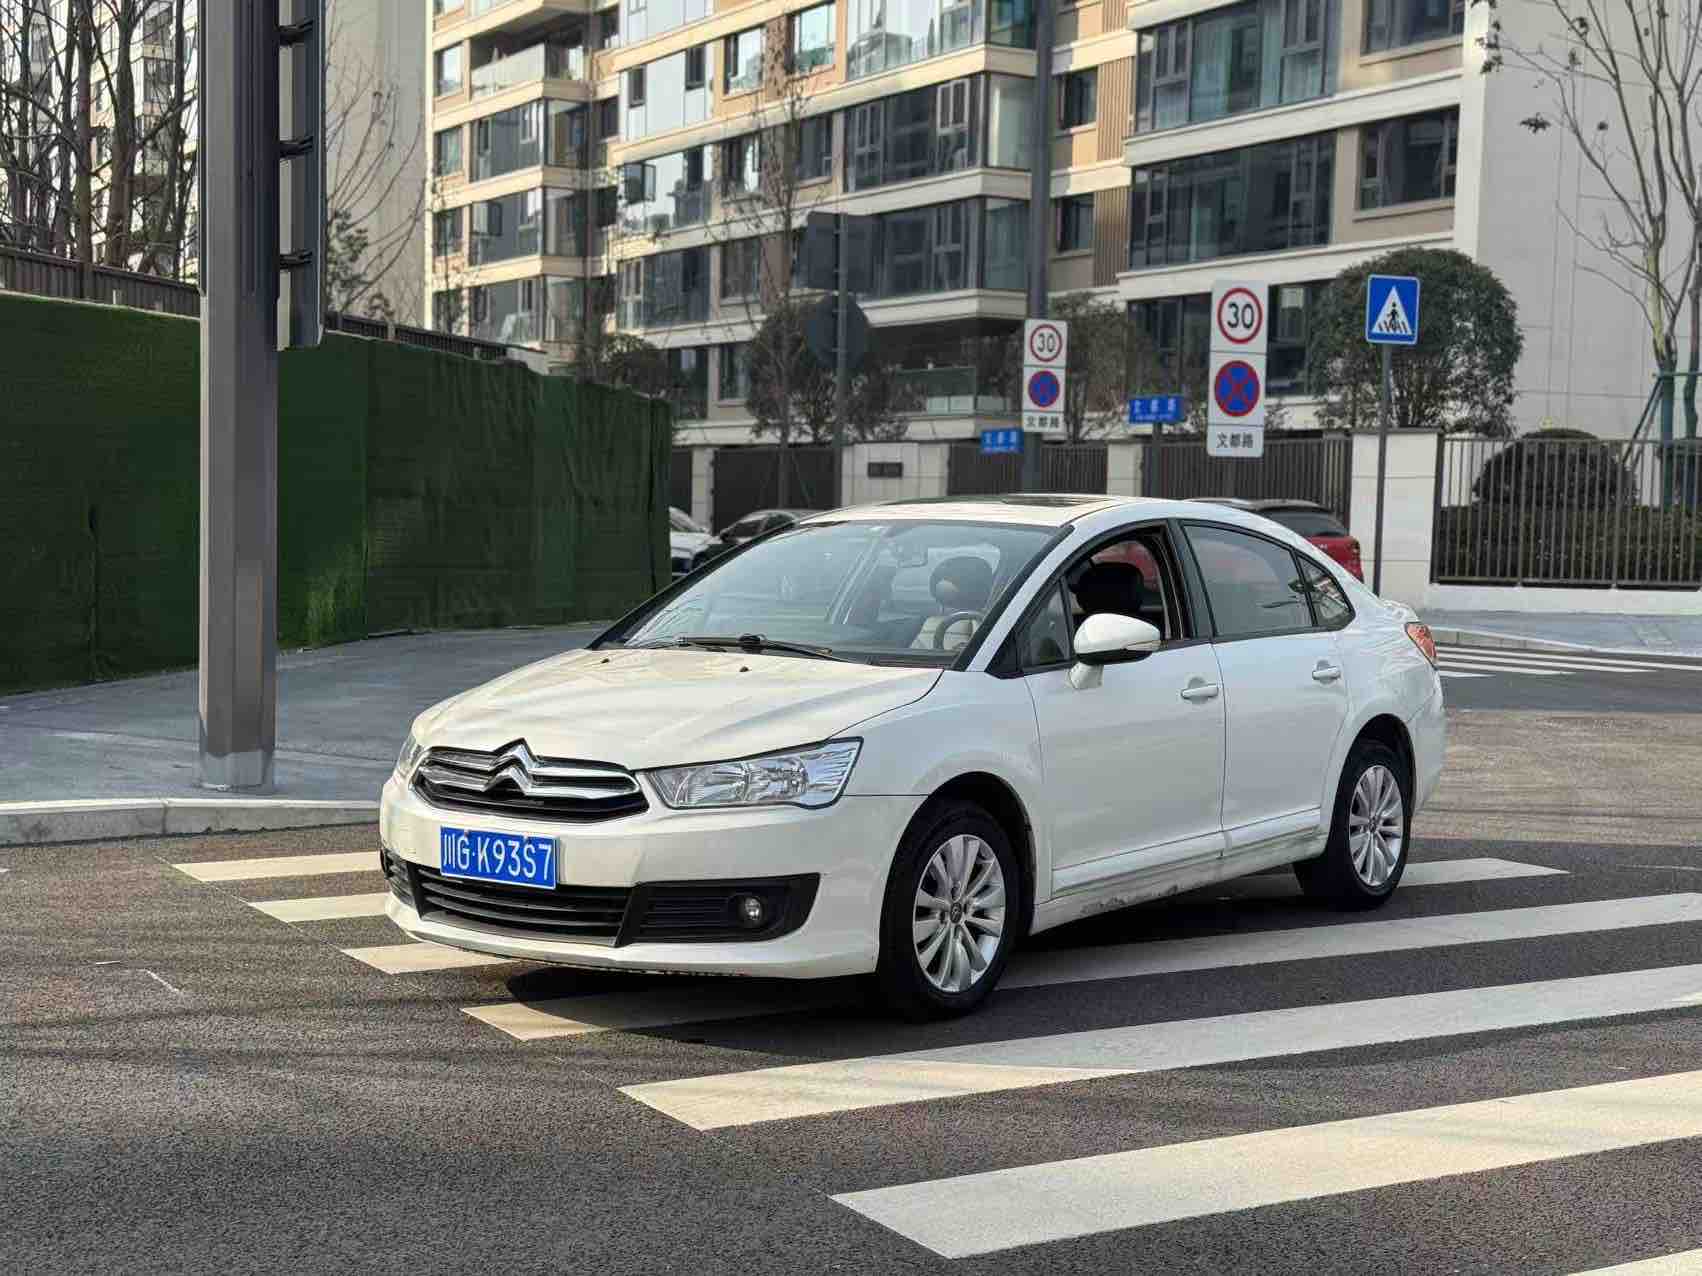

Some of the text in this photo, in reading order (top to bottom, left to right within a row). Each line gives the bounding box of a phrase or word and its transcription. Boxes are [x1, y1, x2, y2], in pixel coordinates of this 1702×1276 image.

[1227, 303, 1255, 329] 30
[1038, 333, 1056, 353] 30
[1216, 432, 1254, 449] 文都路
